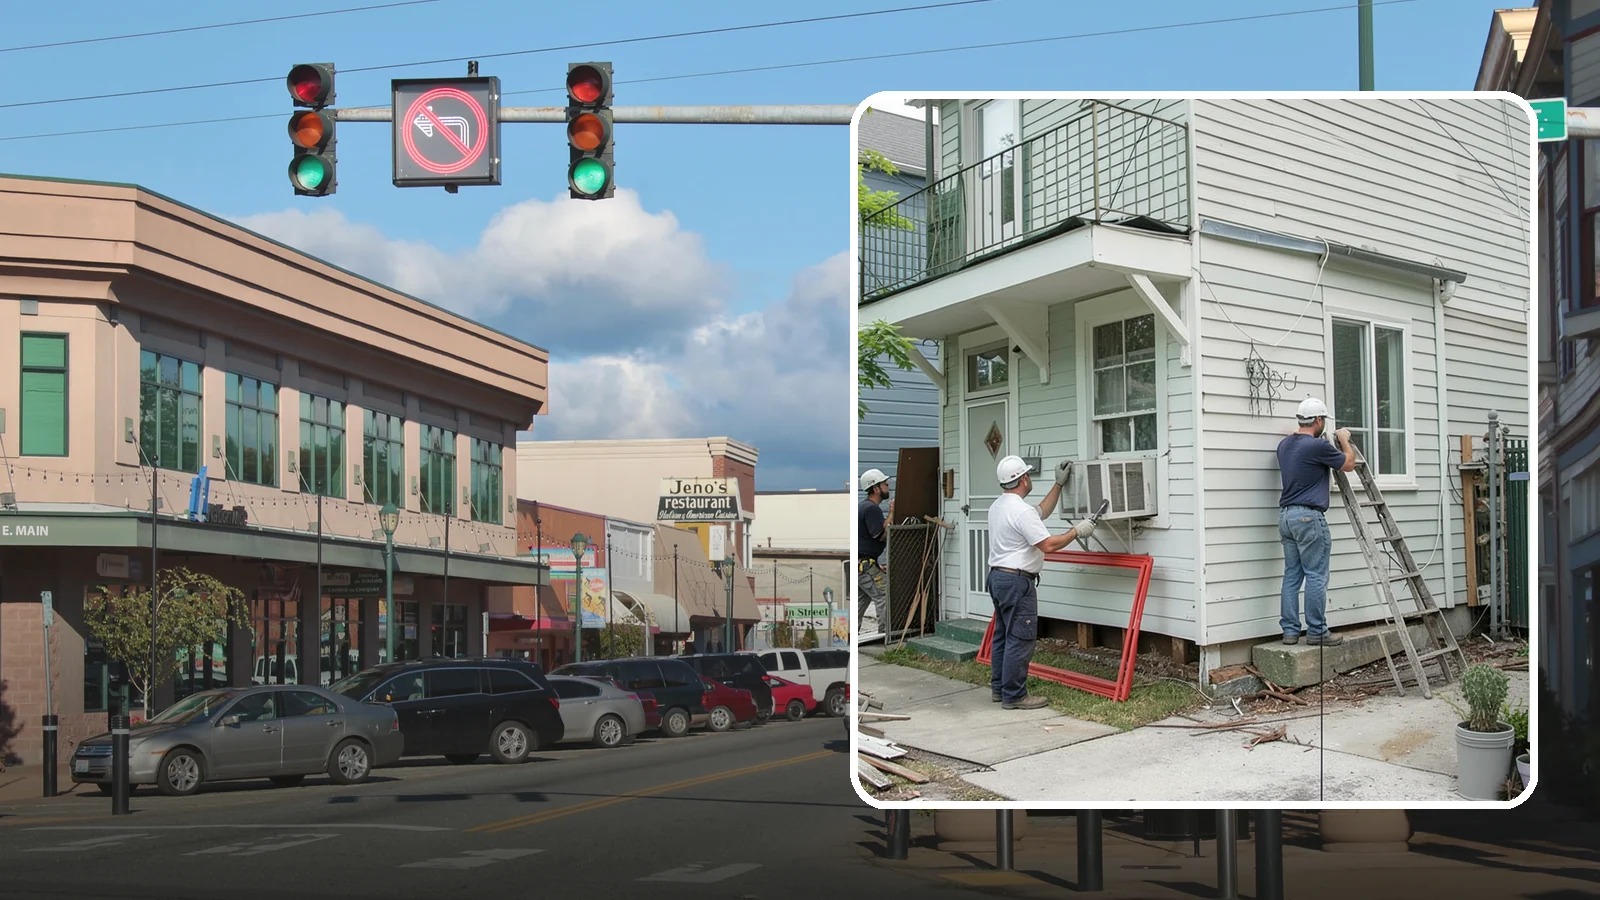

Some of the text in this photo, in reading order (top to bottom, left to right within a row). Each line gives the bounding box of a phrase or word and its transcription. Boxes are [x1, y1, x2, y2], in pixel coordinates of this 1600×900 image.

[669, 480, 727, 494] Jeno's
[665, 496, 731, 509] restaurant
[659, 509, 681, 519] Italian
[686, 509, 714, 519] American
[715, 509, 737, 519] Cuisine
[2, 525, 49, 536] E. MAIN
[797, 608, 828, 616] Street
